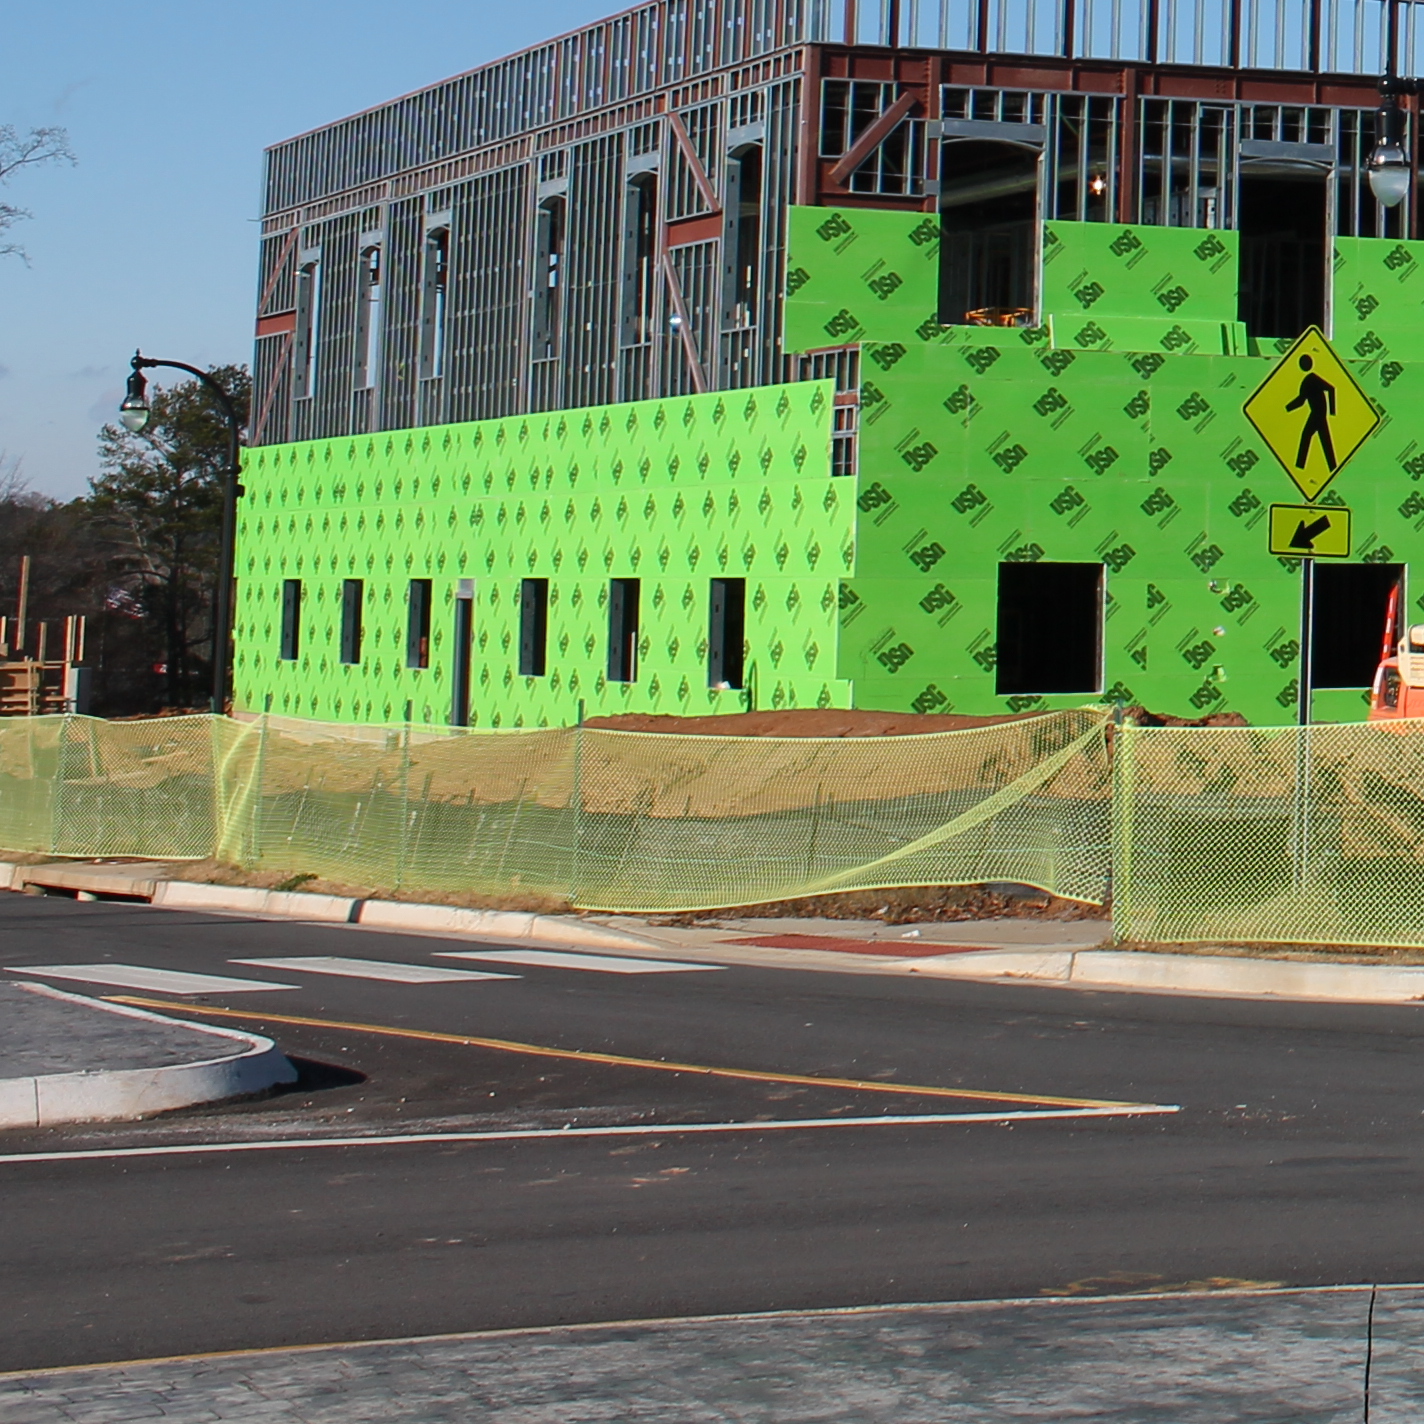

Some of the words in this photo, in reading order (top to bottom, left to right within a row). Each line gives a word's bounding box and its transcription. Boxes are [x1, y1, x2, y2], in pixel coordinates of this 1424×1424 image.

[816, 212, 852, 242] USG
[1109, 228, 1143, 258] USG
[1194, 234, 1225, 261] USG
[1383, 244, 1413, 271] USG
[868, 272, 903, 301] USG
[1158, 285, 1191, 314] USG
[824, 309, 859, 338] USG
[1074, 320, 1107, 348] USG
[1160, 325, 1192, 352] USG
[1354, 331, 1383, 357] USG
[871, 344, 907, 371] USG
[966, 346, 1001, 374] USG
[1041, 350, 1076, 377] USG
[1132, 352, 1166, 380] USG
[1033, 388, 1068, 417] USG
[1178, 392, 1210, 421] USG
[902, 442, 938, 473] USG
[992, 444, 1029, 474] USG
[1084, 446, 1119, 475] USG
[1226, 449, 1259, 478] USG
[858, 482, 893, 513] USG
[951, 484, 988, 514] USG
[1049, 485, 1085, 516] USG
[1141, 487, 1175, 517] USG
[1228, 488, 1261, 518] USG
[909, 542, 946, 573] USG
[1101, 544, 1137, 574] USG
[1191, 544, 1223, 574] USG
[919, 583, 956, 614] USG
[1221, 584, 1253, 613] USG
[876, 642, 914, 674] USG
[1182, 640, 1216, 669] USG
[912, 684, 948, 714] USG
[1189, 679, 1223, 710] USG
